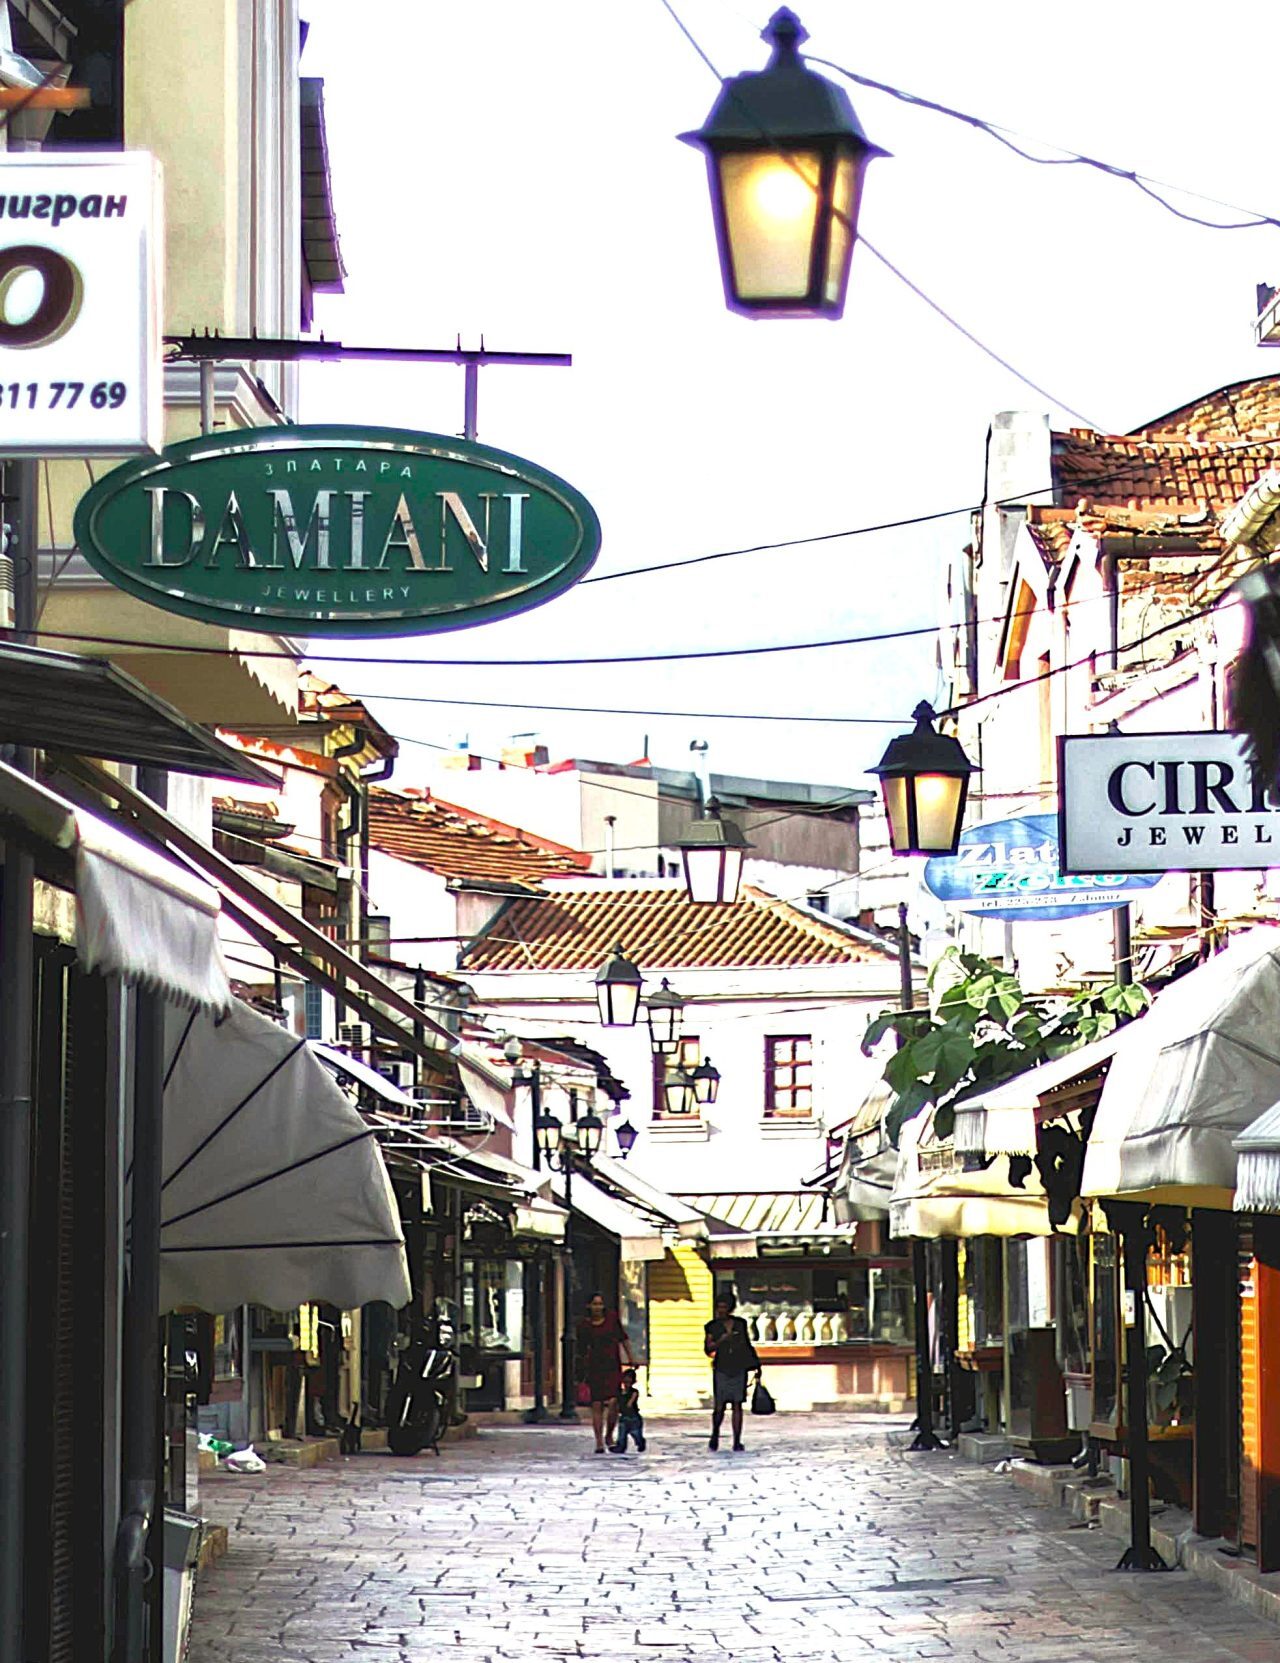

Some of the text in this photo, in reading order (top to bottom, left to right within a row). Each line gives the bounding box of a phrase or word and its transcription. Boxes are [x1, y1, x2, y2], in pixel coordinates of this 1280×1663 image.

[0, 382, 38, 409] 11
[142, 486, 530, 574] DAMIANI
[262, 585, 411, 603] JEWELLERY
